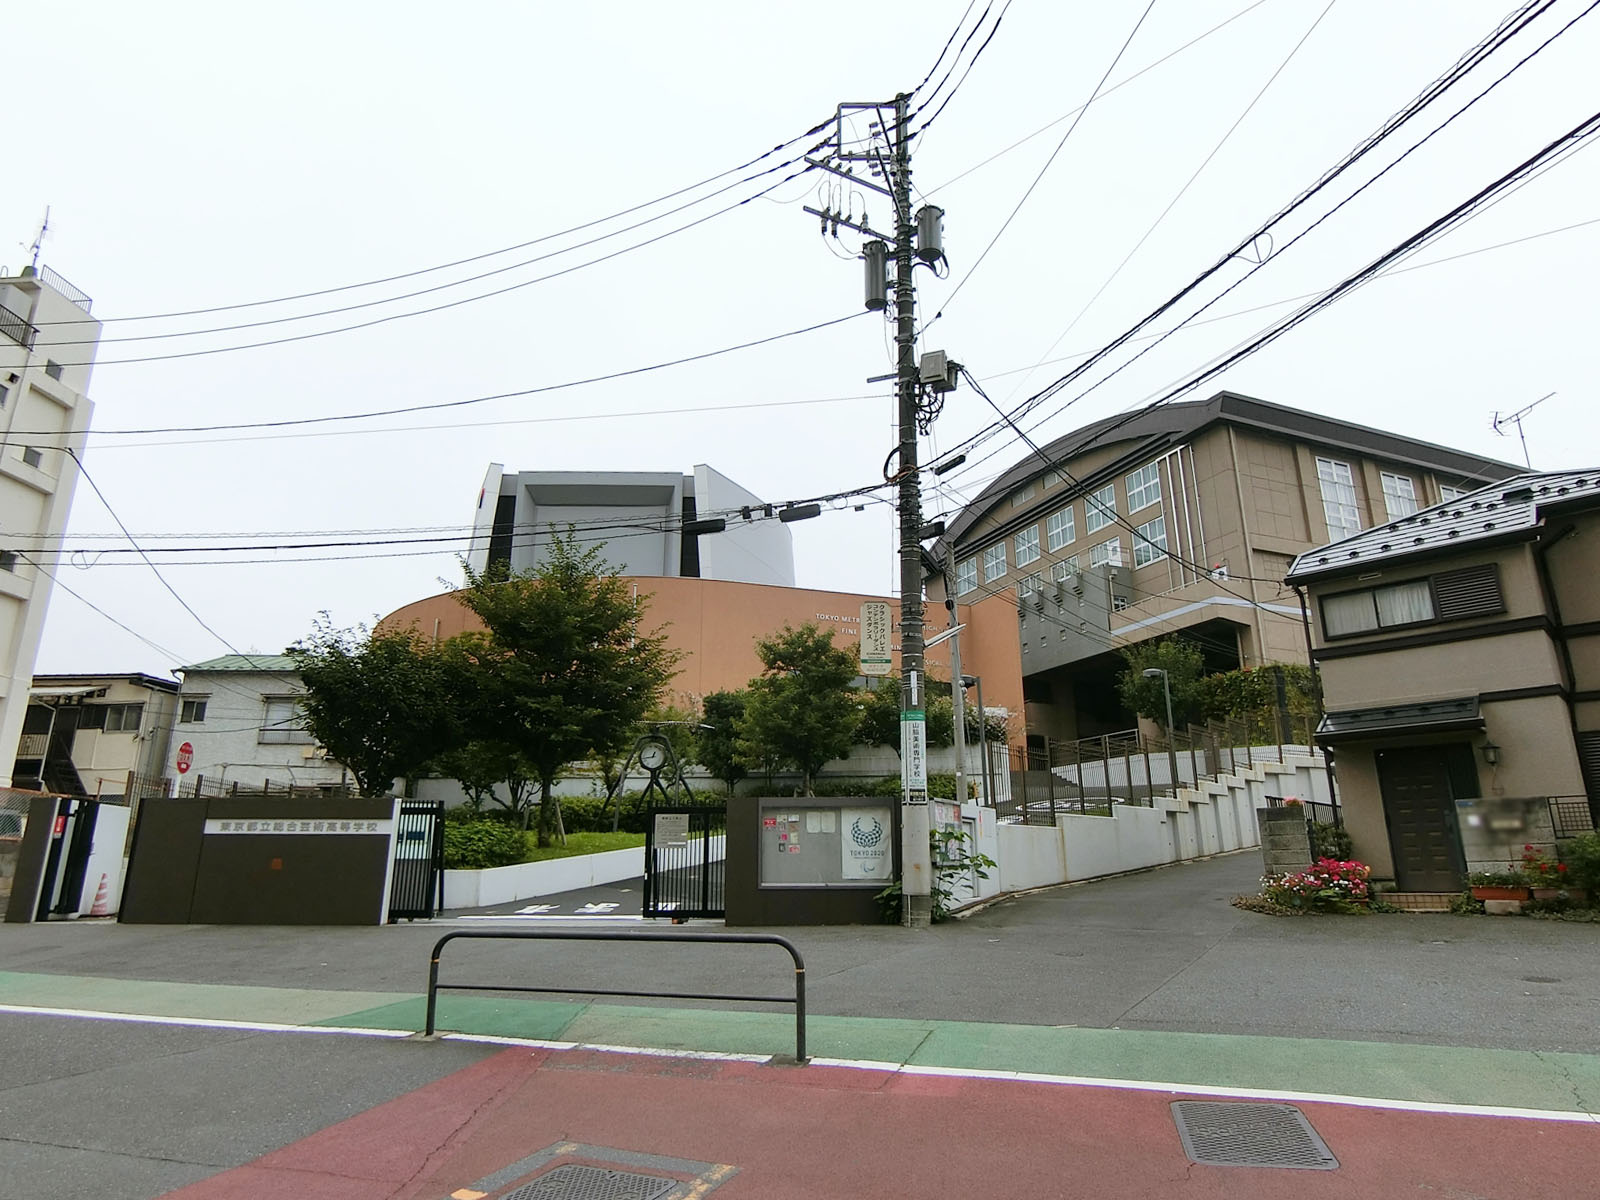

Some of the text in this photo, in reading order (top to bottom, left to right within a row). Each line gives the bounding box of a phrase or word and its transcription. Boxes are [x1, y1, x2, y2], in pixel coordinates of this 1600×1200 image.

[816, 613, 840, 623] TOKYO
[912, 722, 920, 777] 山脇美術専門学校
[220, 822, 378, 832] 東京都立総合芸術高等学校
